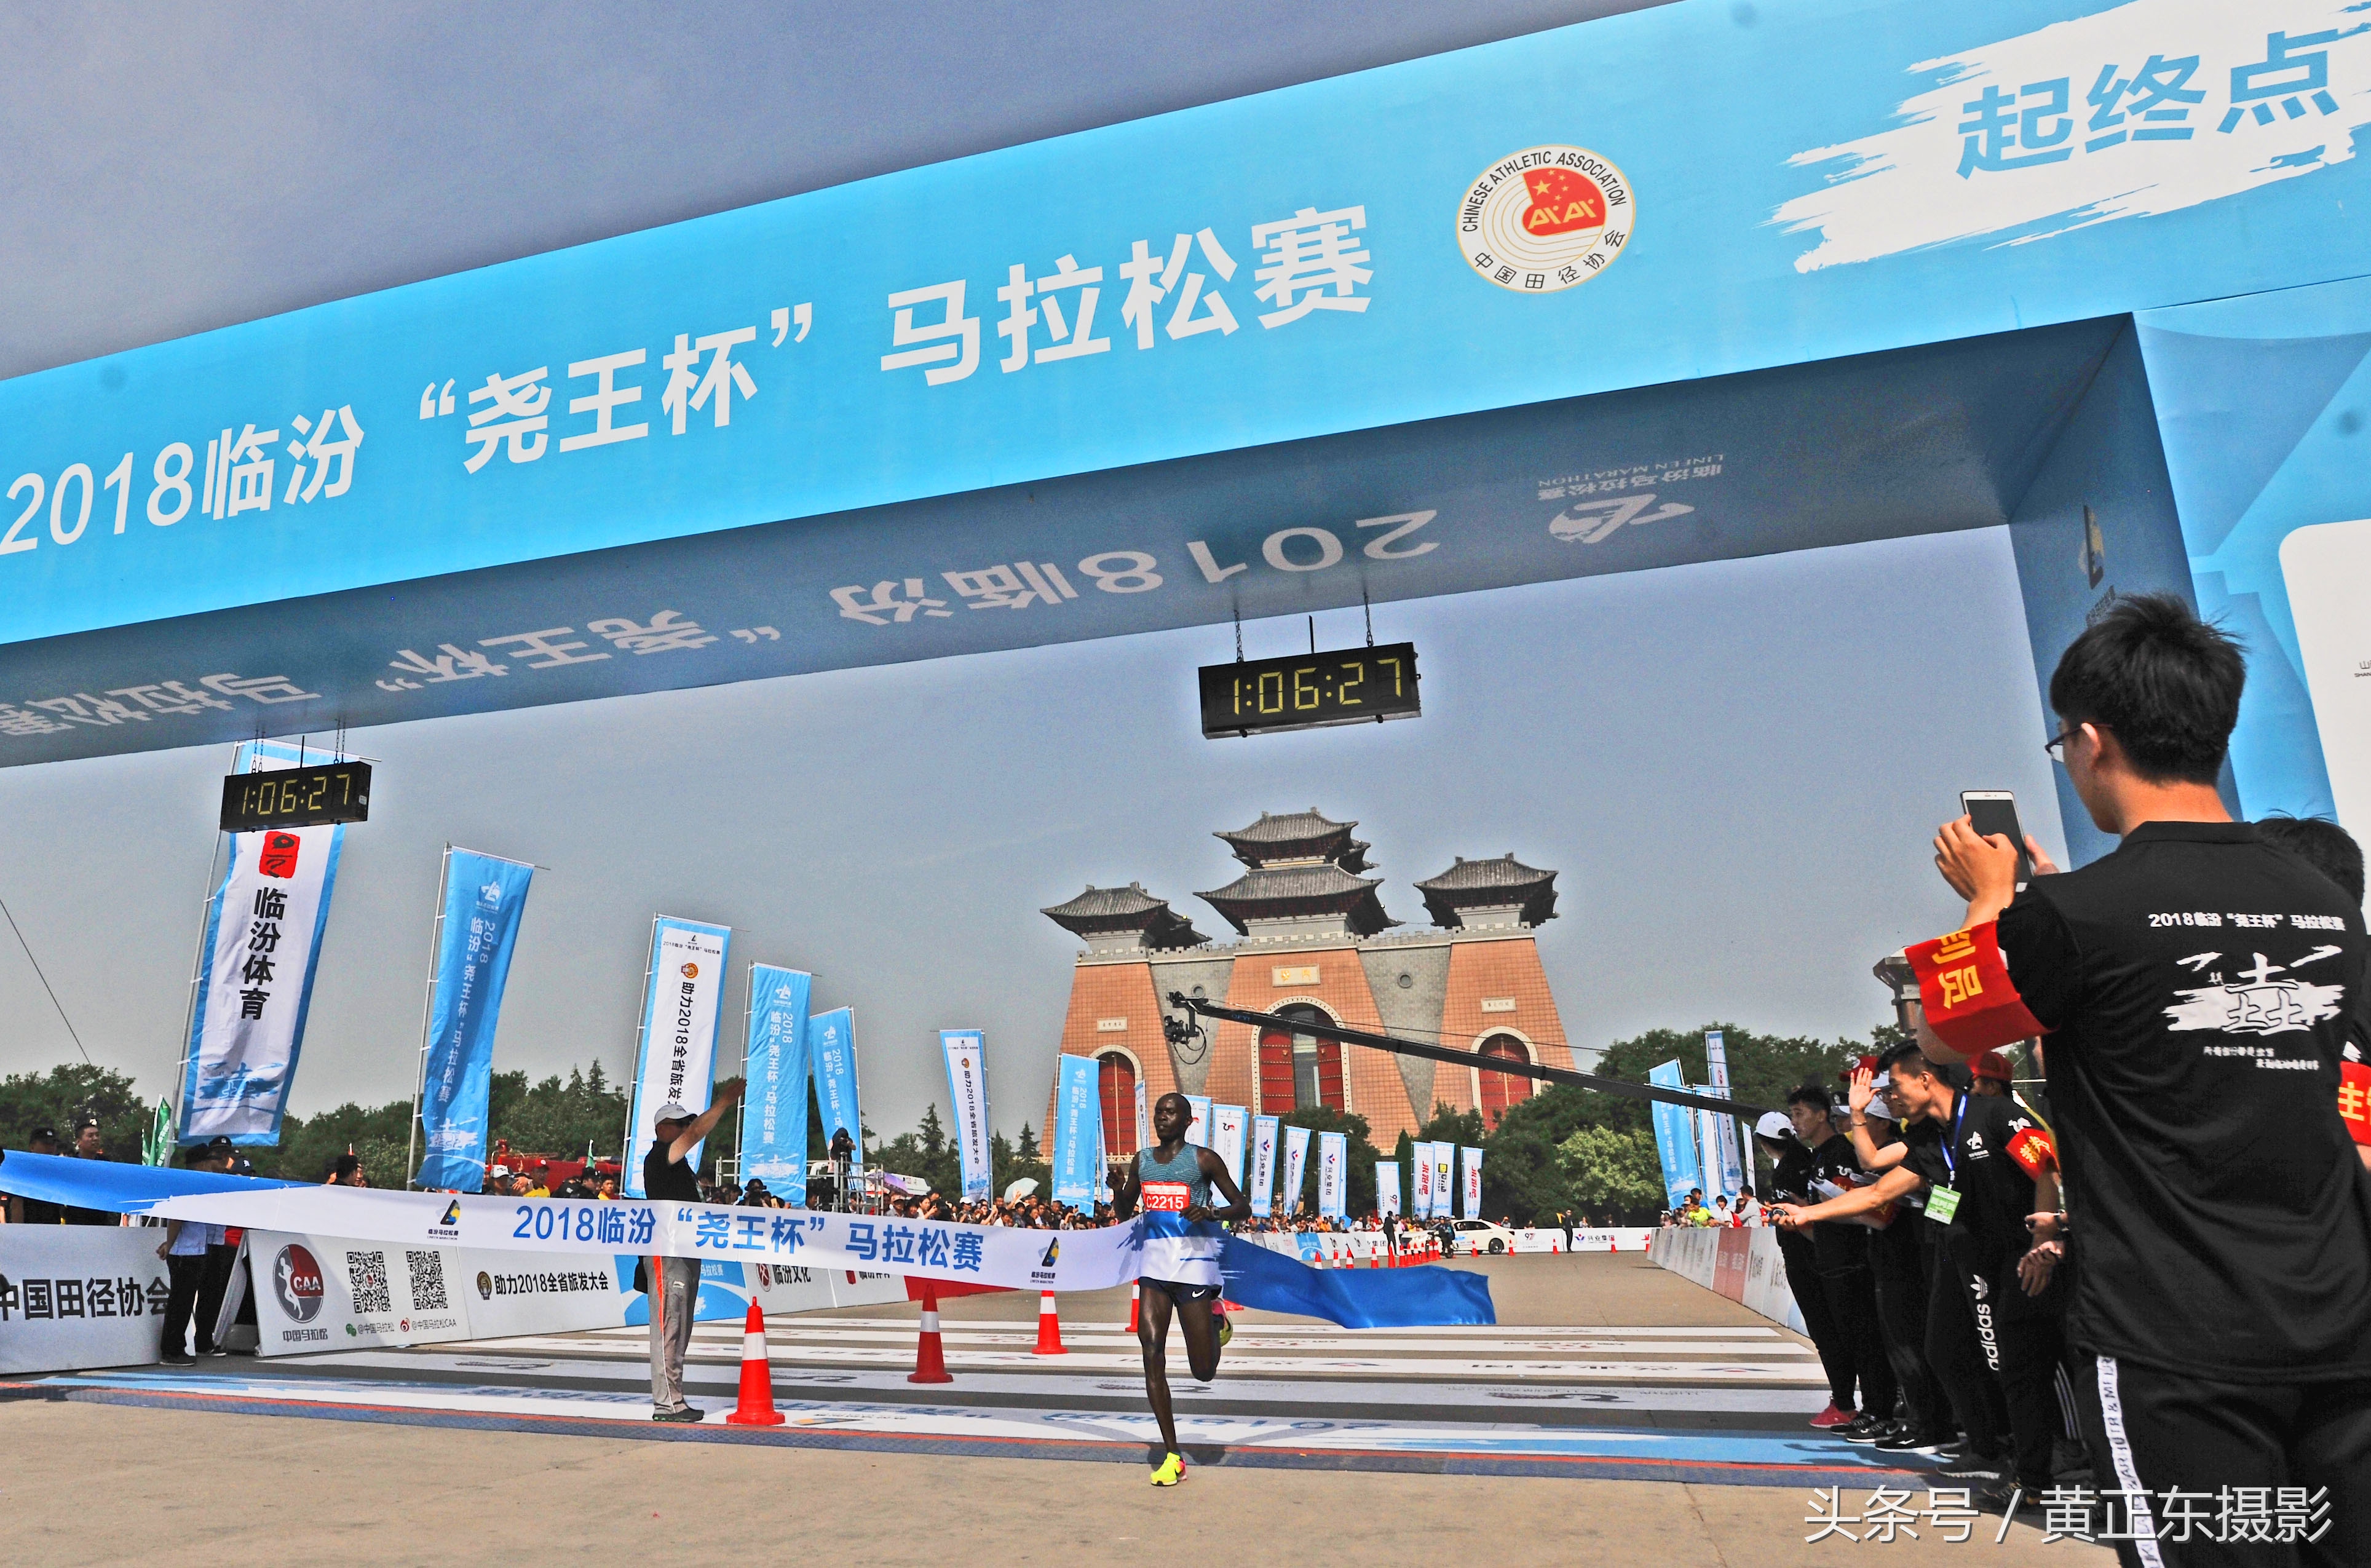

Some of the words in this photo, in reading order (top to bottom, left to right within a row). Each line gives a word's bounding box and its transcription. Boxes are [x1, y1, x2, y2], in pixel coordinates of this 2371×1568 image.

[1956, 28, 2340, 178] 起终点
[1463, 181, 1493, 232] CHINESE
[1489, 151, 1551, 185] ATHLETIC
[1556, 152, 1627, 207] ASSOCIATION
[1475, 230, 1626, 289] 中国田径协会
[1537, 464, 1722, 501] 临汾马拉松赛
[1538, 465, 1649, 487] MARATHON
[1233, 657, 1402, 716] 1:06:27
[242, 772, 352, 815] 1:06:27
[239, 886, 288, 1021] 临汾体育
[479, 920, 496, 964] 2018
[668, 981, 695, 1105] 助力2018全省旅发
[782, 1012, 794, 1043] 2018
[832, 1048, 844, 1075] 2018
[823, 1051, 843, 1130] 临汾“尧王杯”马
[1146, 1195, 1184, 1210] C2215
[293, 1276, 322, 1291] CAA
[494, 1271, 609, 1296] 助力2018全省旅发大会
[772, 1263, 811, 1285] 临汾文化
[283, 1328, 328, 1342] 中国马拉松
[357, 1323, 395, 1334] @中国马拉松
[411, 1319, 457, 1331] @中国马拉松CAA
[1976, 1303, 1999, 1371] adidas
